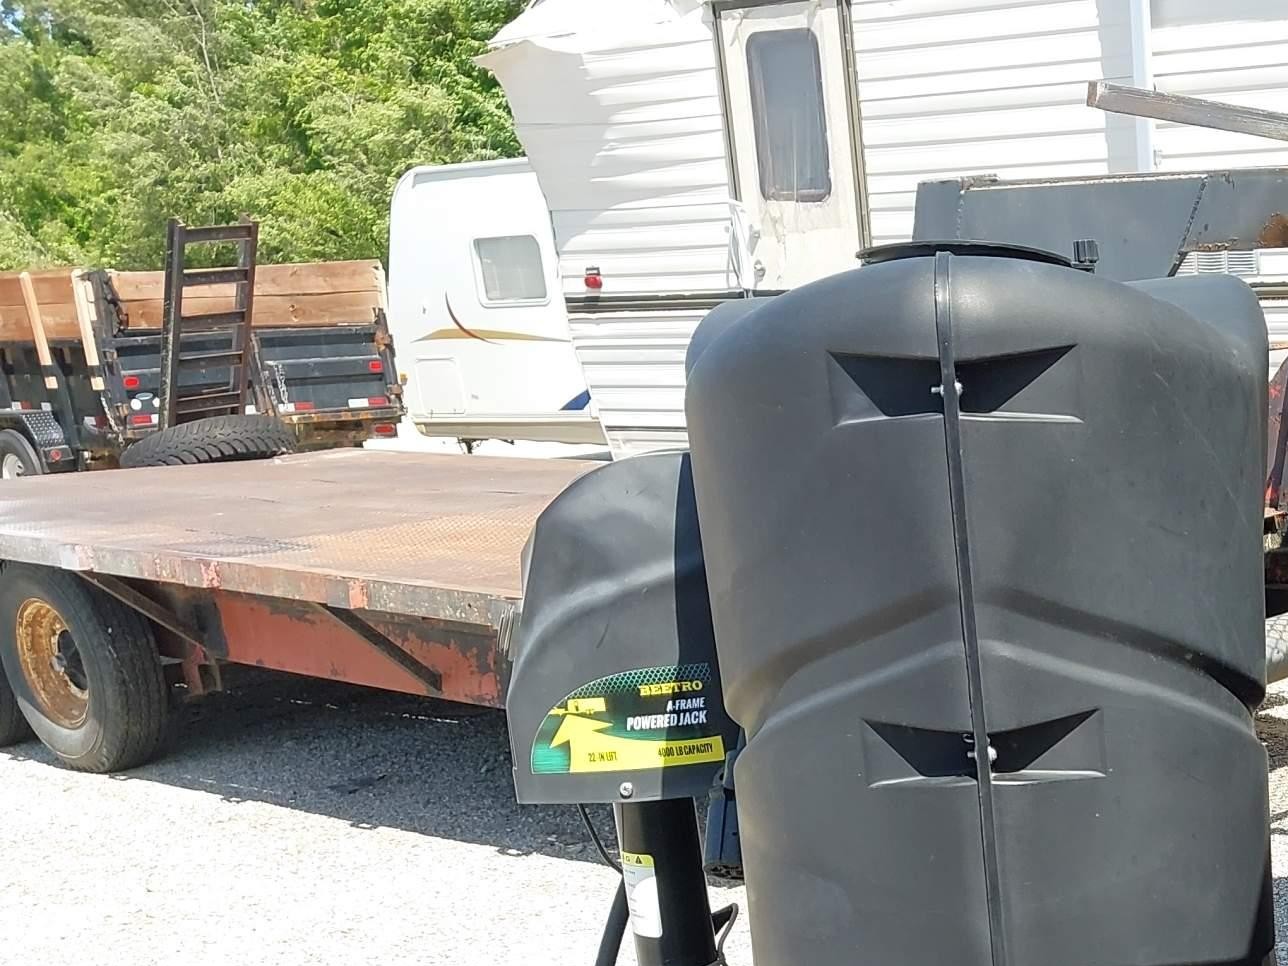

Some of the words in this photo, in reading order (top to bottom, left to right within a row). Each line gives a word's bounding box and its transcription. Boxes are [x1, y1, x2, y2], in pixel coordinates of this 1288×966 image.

[638, 680, 703, 696] BEETRO
[666, 697, 705, 712] A-FRAME
[626, 713, 678, 731] POWERED
[678, 710, 707, 725] JACK
[675, 745, 684, 756] LB
[684, 743, 714, 756] CAPACITY
